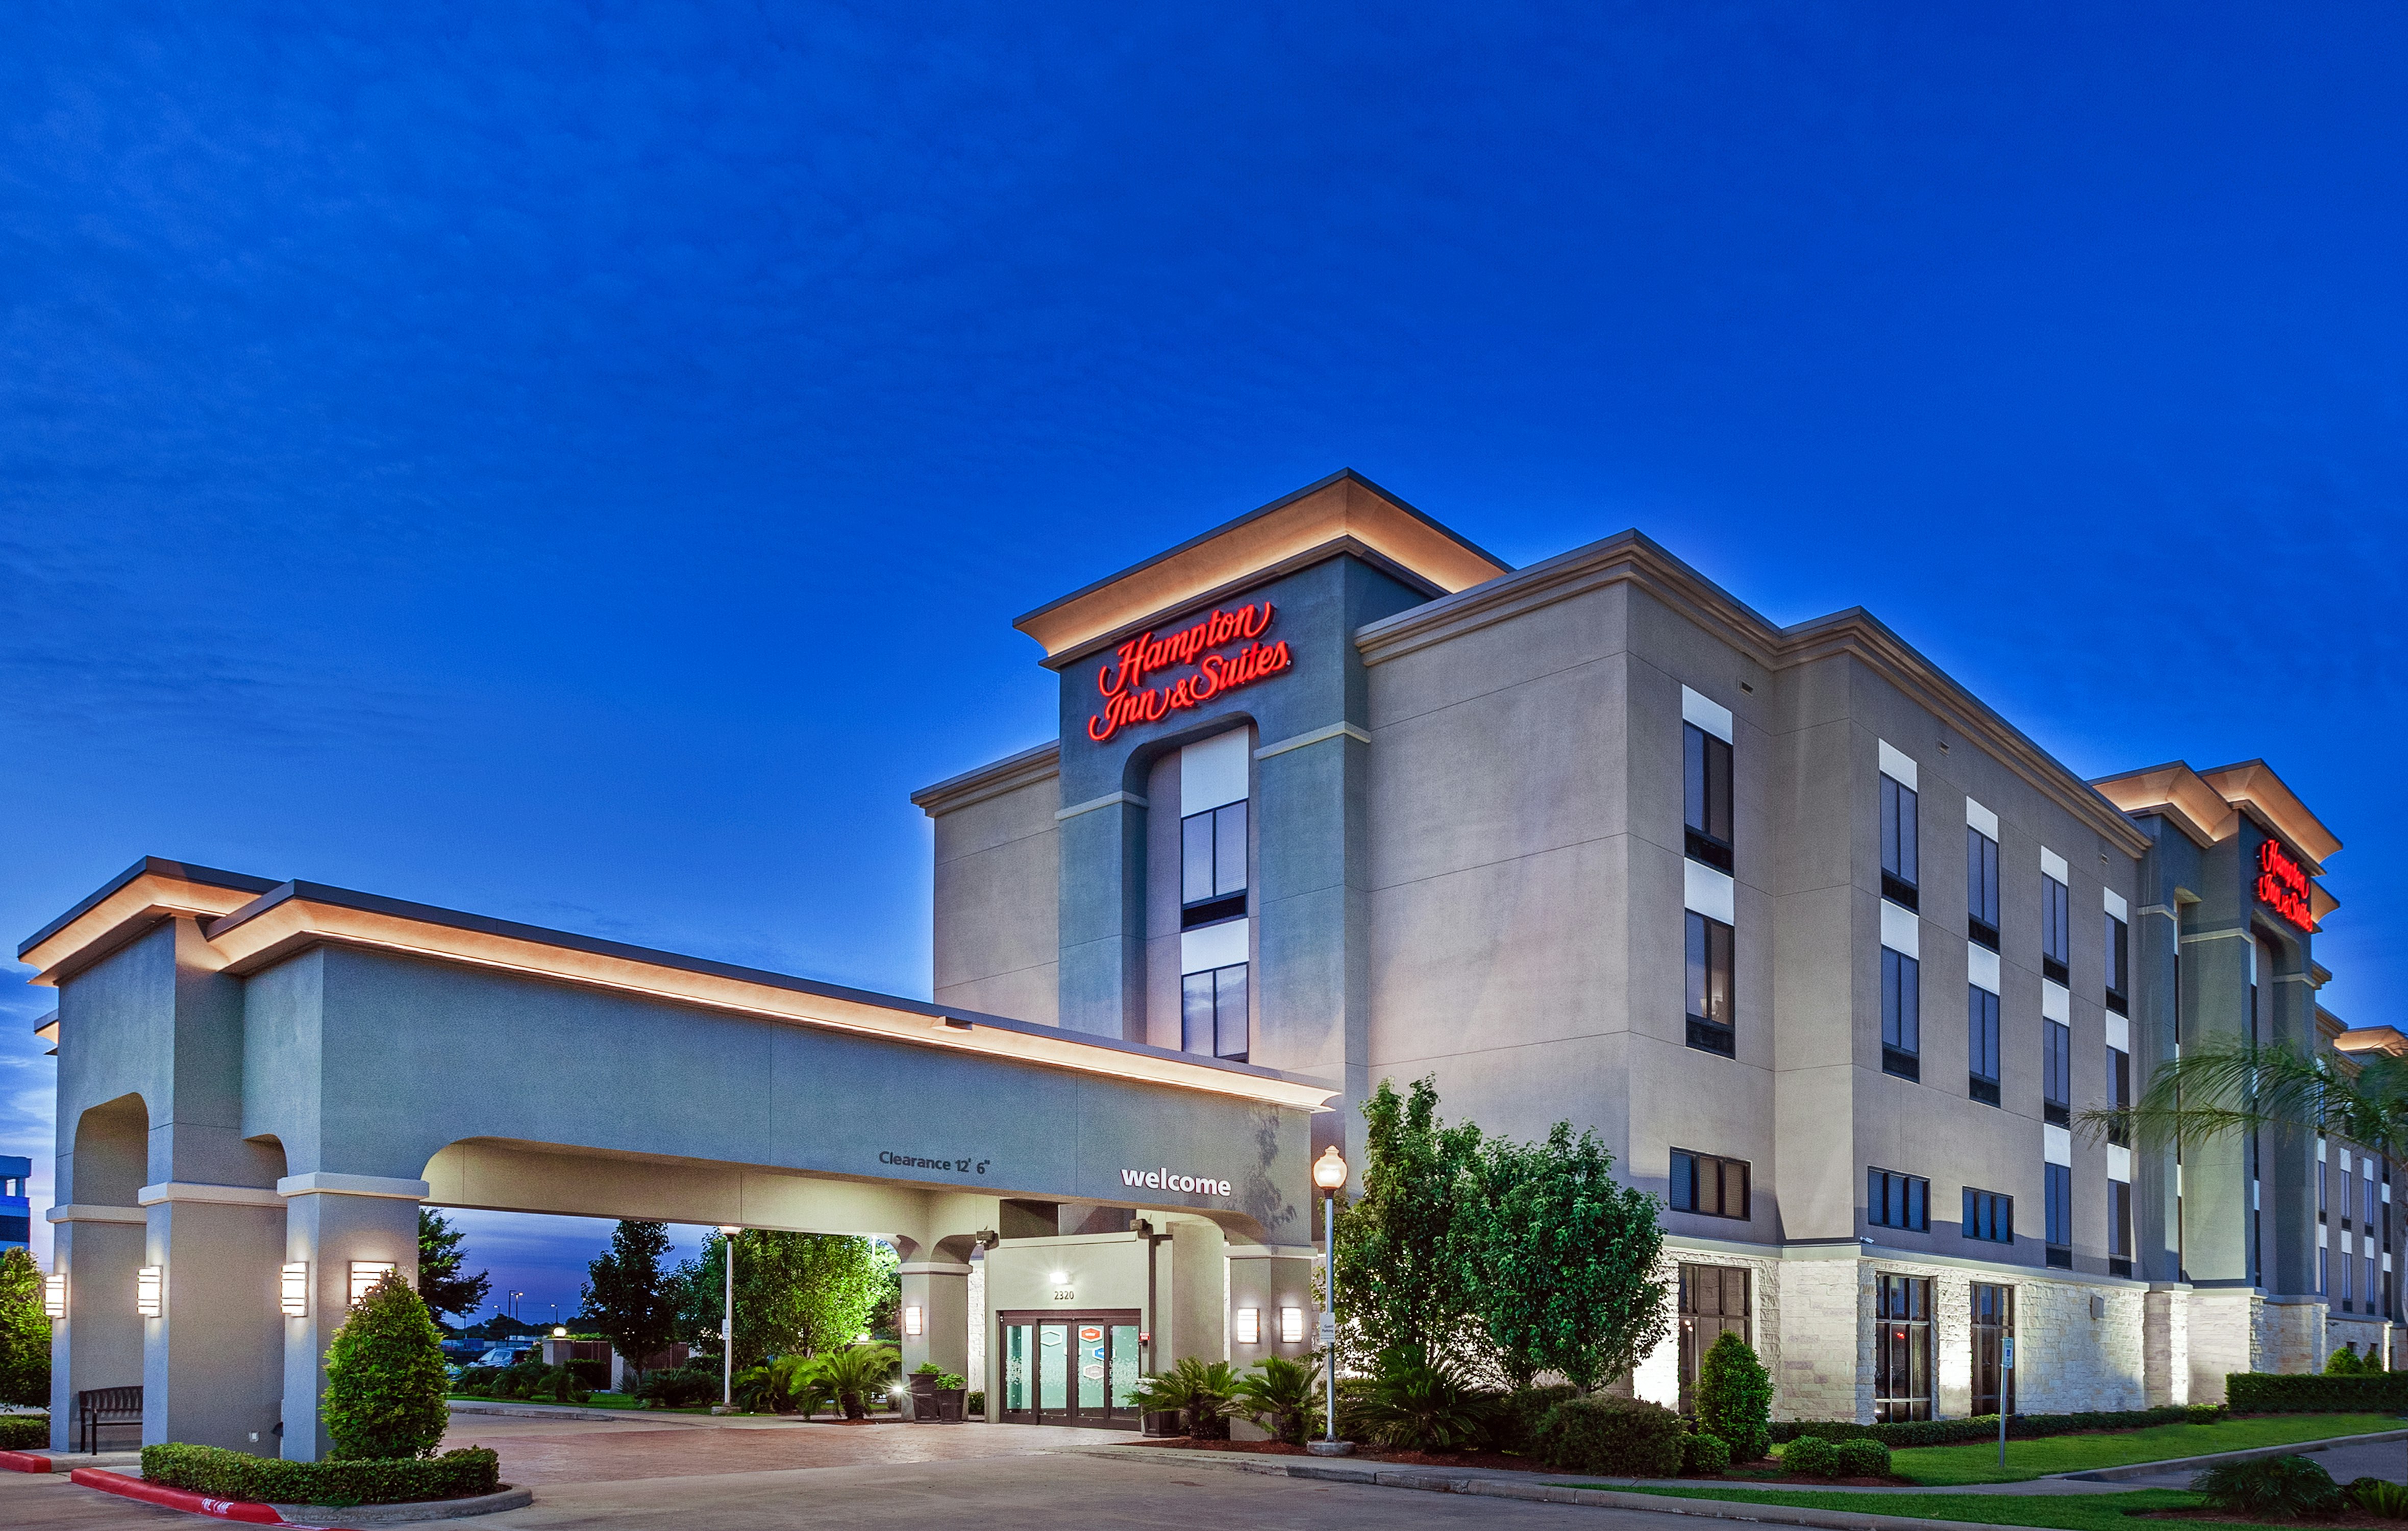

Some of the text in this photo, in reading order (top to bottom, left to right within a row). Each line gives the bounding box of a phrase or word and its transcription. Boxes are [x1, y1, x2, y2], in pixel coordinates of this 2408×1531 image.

[1098, 601, 1271, 697] Hampton
[1087, 640, 1288, 741] Inn & Suites
[879, 1151, 991, 1175] Clearance 12' 6"
[1120, 1167, 1232, 1197] welcome
[1054, 1290, 1075, 1300] 2320
